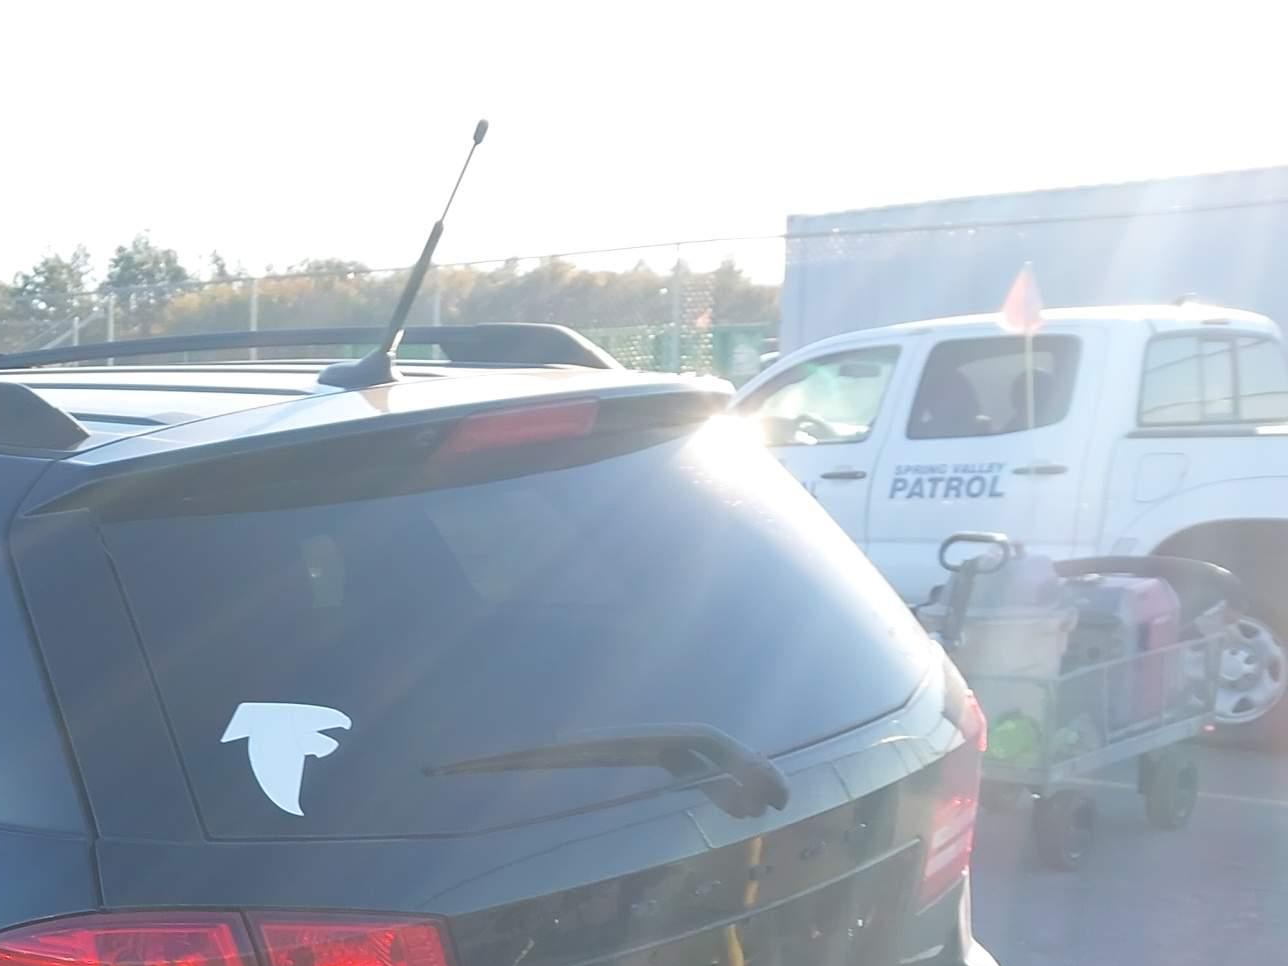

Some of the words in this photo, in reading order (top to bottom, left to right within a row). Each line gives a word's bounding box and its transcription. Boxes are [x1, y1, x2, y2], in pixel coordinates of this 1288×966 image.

[895, 463, 948, 476] SPRING
[952, 462, 1007, 474] VALLEY
[888, 475, 1006, 499] PATROL
